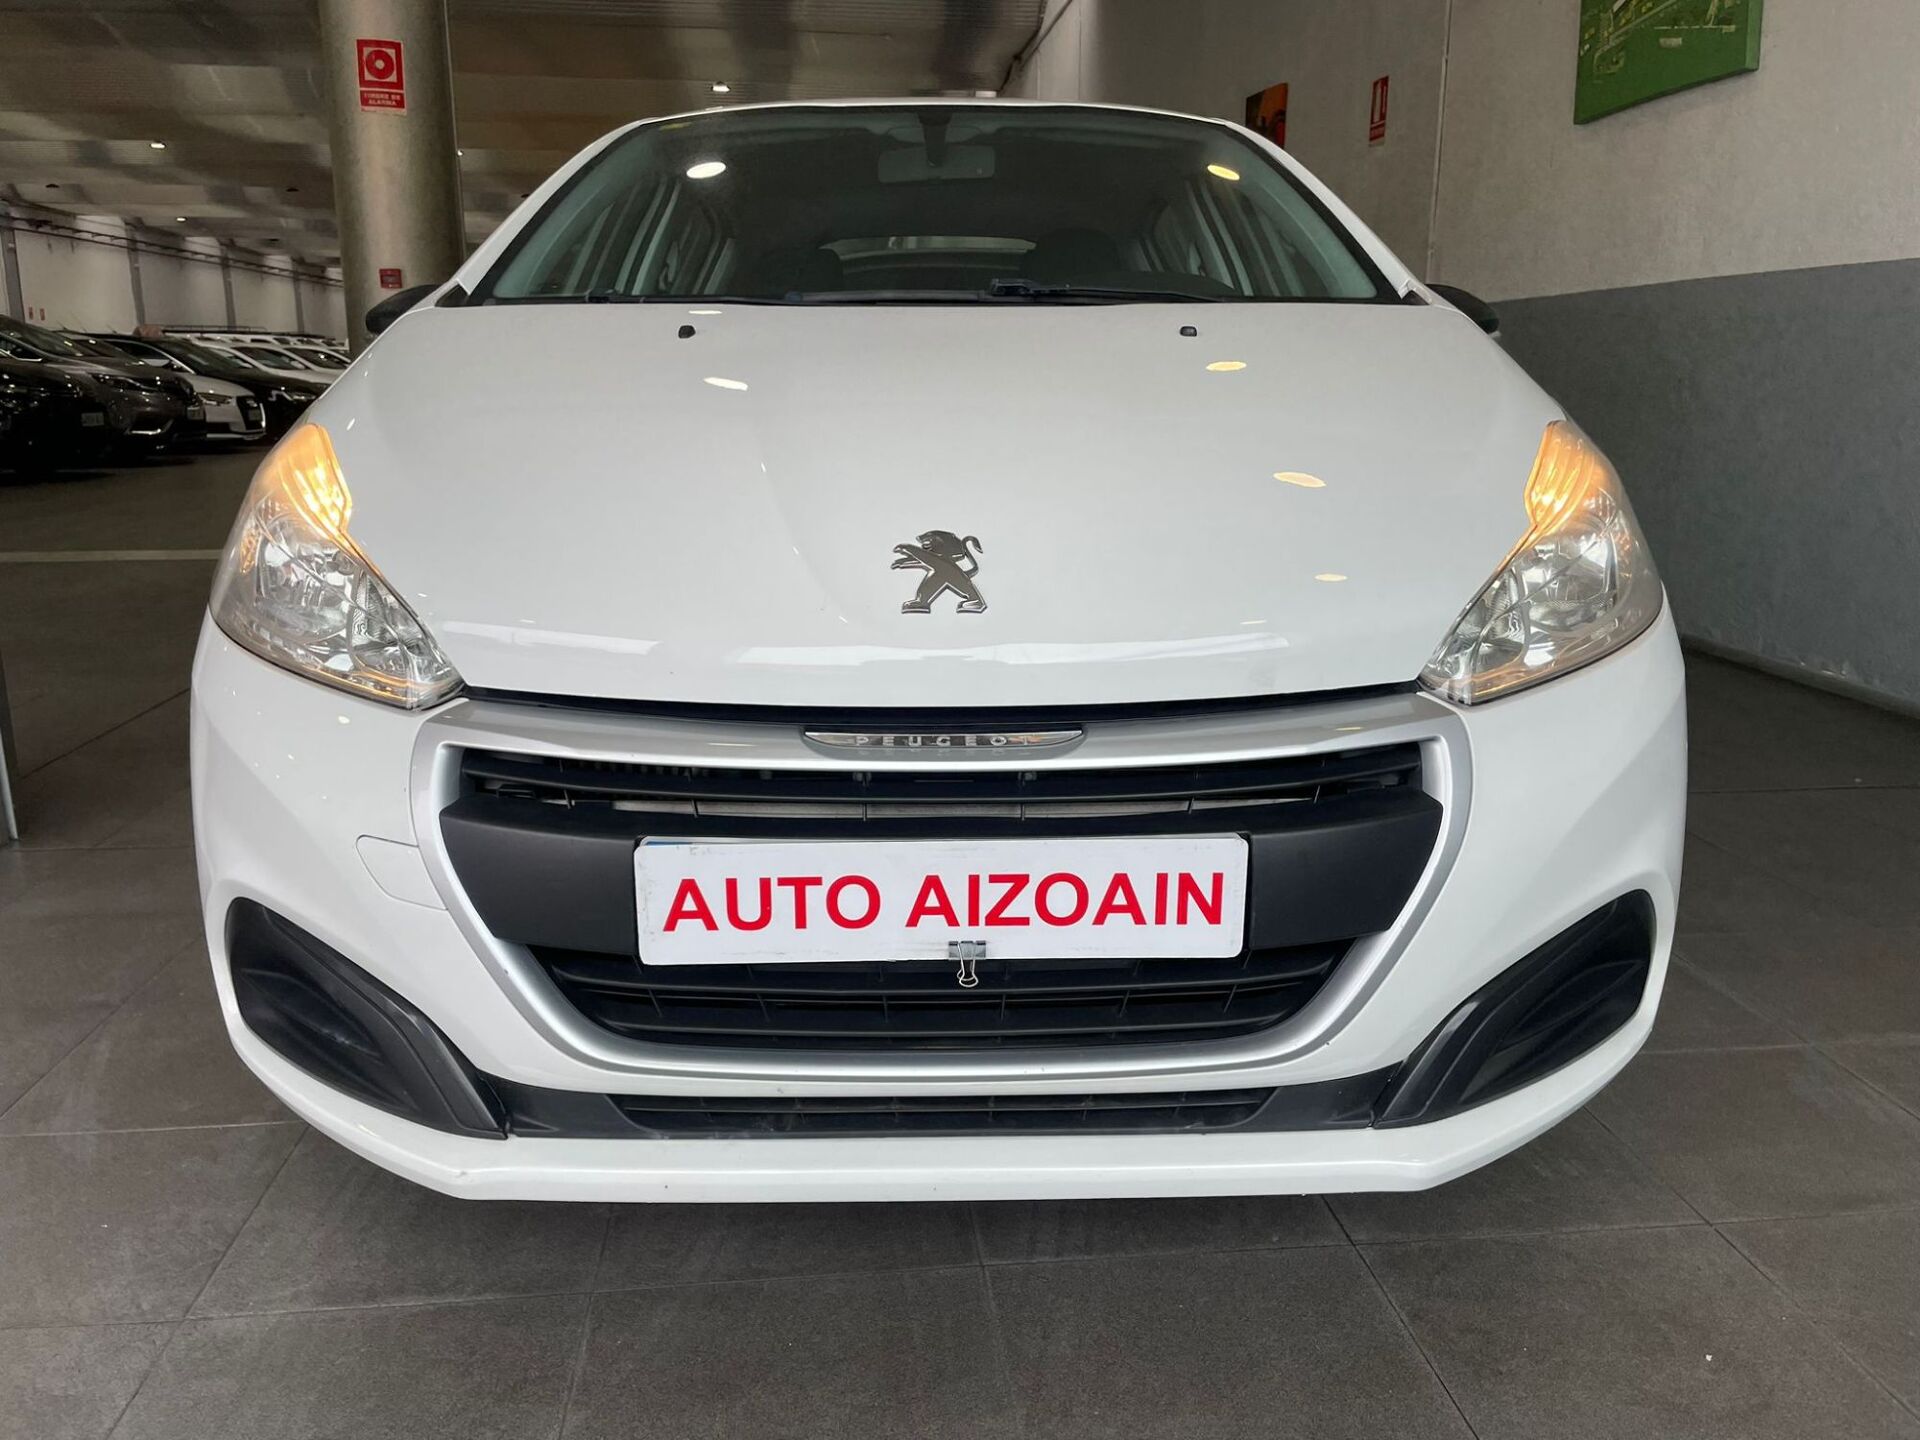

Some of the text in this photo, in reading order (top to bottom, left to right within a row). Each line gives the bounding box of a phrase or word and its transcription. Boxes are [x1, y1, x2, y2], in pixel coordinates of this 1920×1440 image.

[856, 735, 1033, 747] PEUGEOT
[663, 872, 1224, 932] AUTO AIZOAIN
